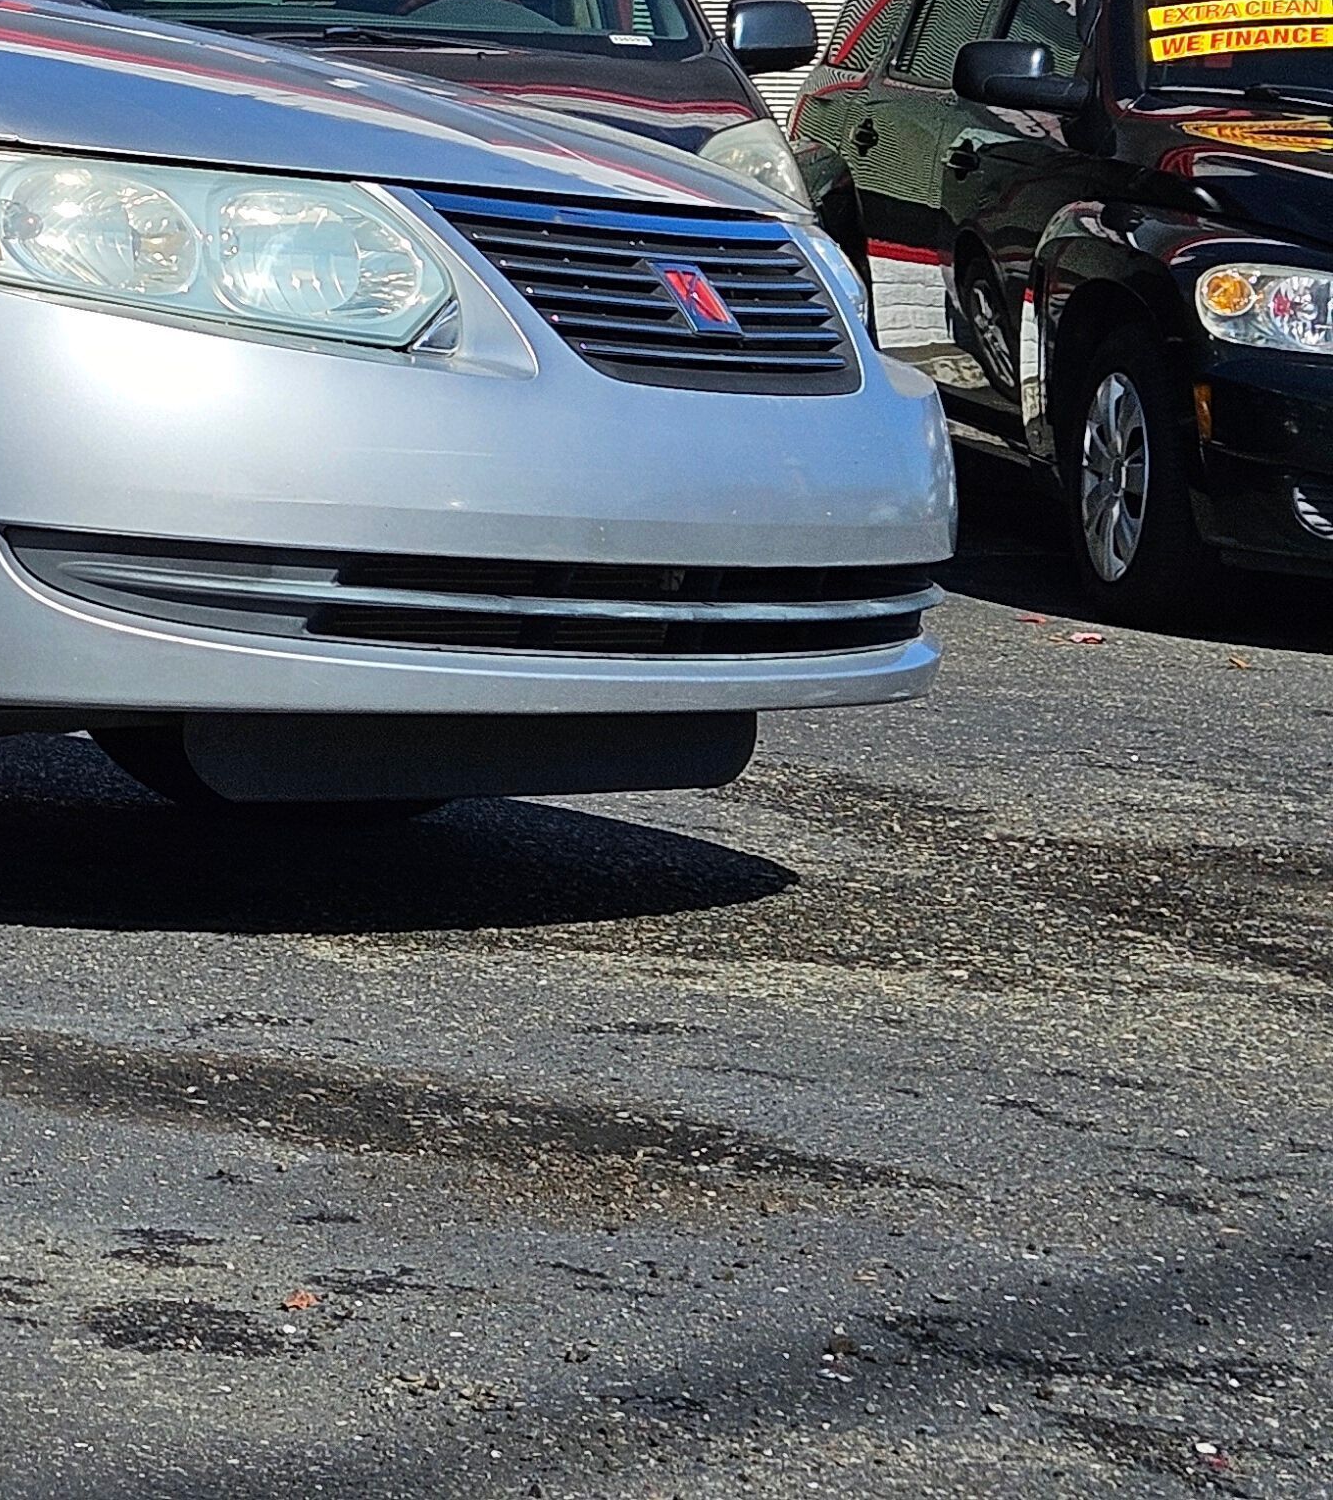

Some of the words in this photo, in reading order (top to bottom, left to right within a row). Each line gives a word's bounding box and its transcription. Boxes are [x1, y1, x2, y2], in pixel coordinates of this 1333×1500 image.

[1162, 2, 1239, 25] EXTRA
[1245, 0, 1321, 16] CLEAN
[1161, 34, 1203, 56] WE
[1209, 27, 1327, 50] FINANCE
